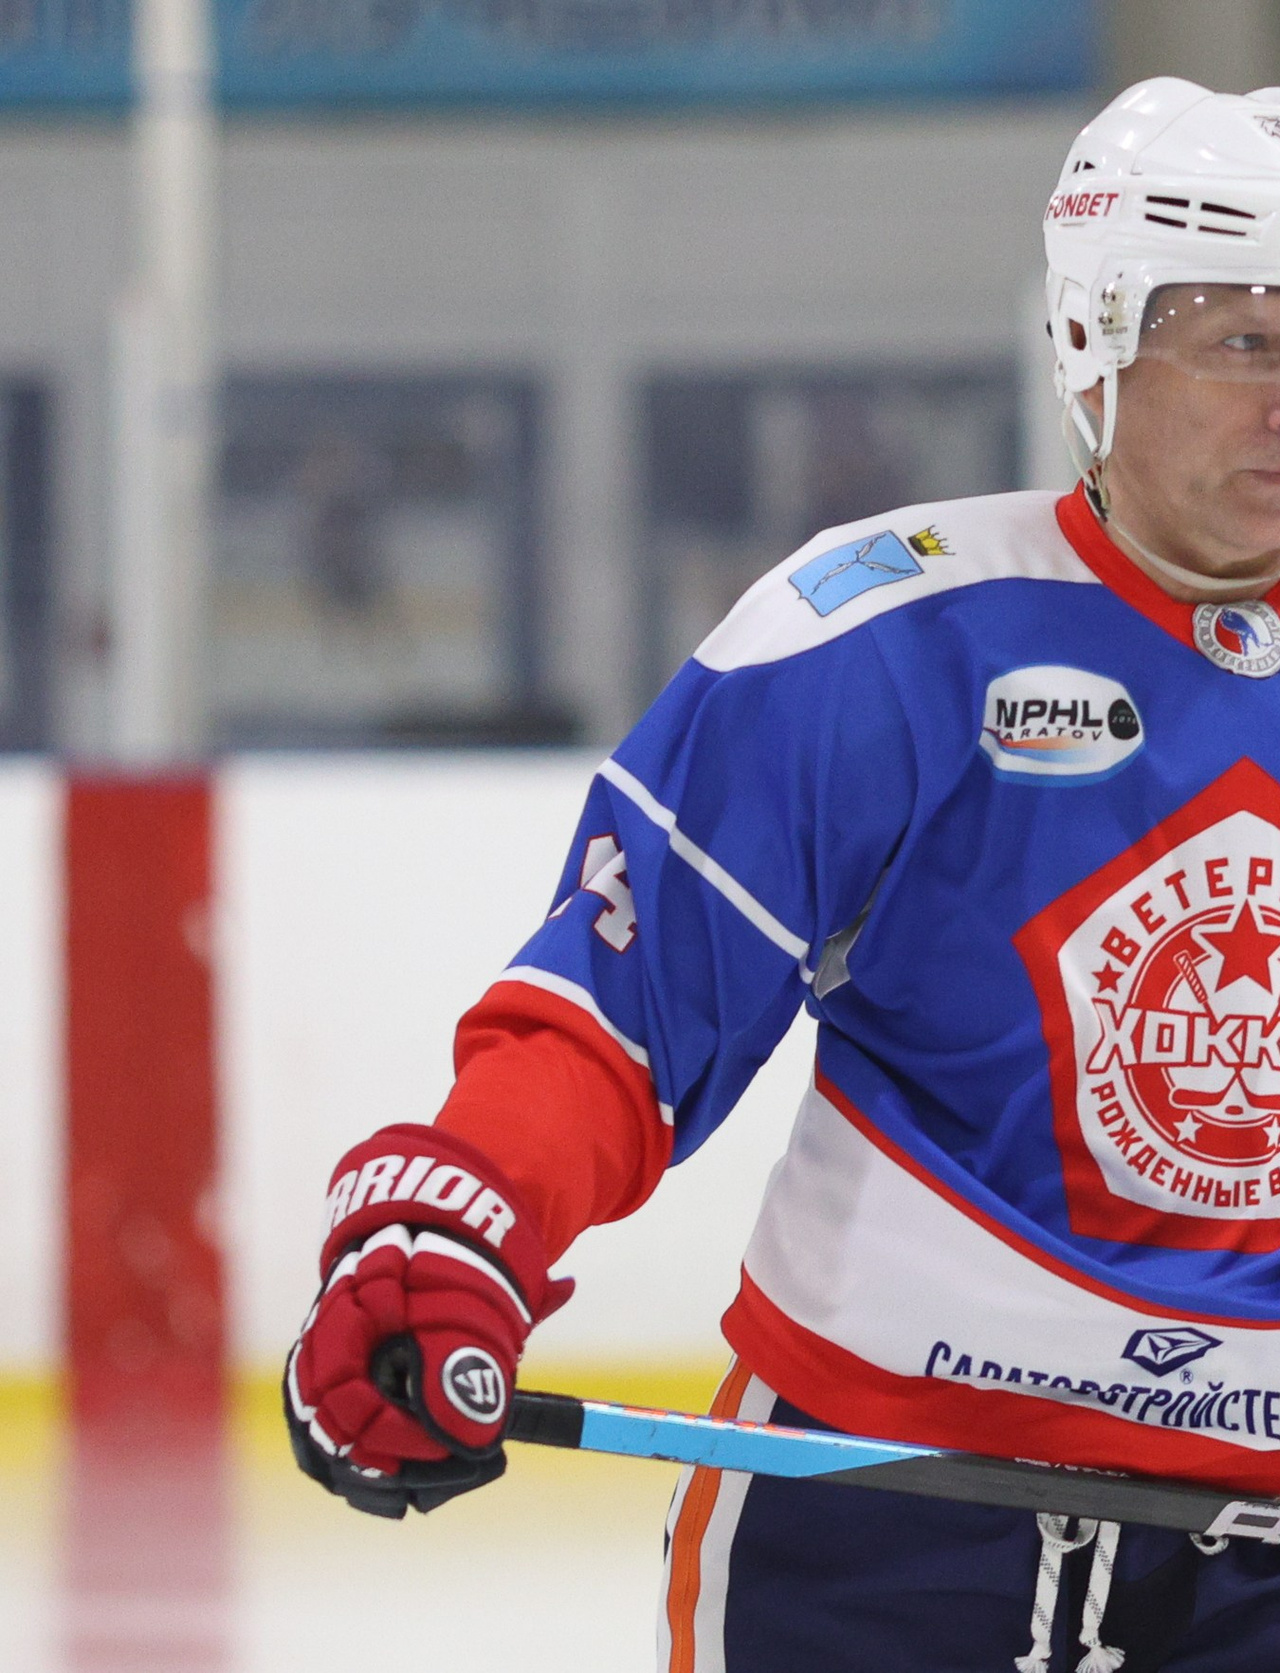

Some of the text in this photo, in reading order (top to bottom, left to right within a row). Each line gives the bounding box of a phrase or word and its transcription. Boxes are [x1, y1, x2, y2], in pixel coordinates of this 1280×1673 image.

[996, 698, 1103, 729] NPHL
[997, 727, 1103, 743] ARATOV
[1091, 1081, 1260, 1207] РОЖДЕННЫЕ
[326, 1154, 516, 1249] RRIOR
